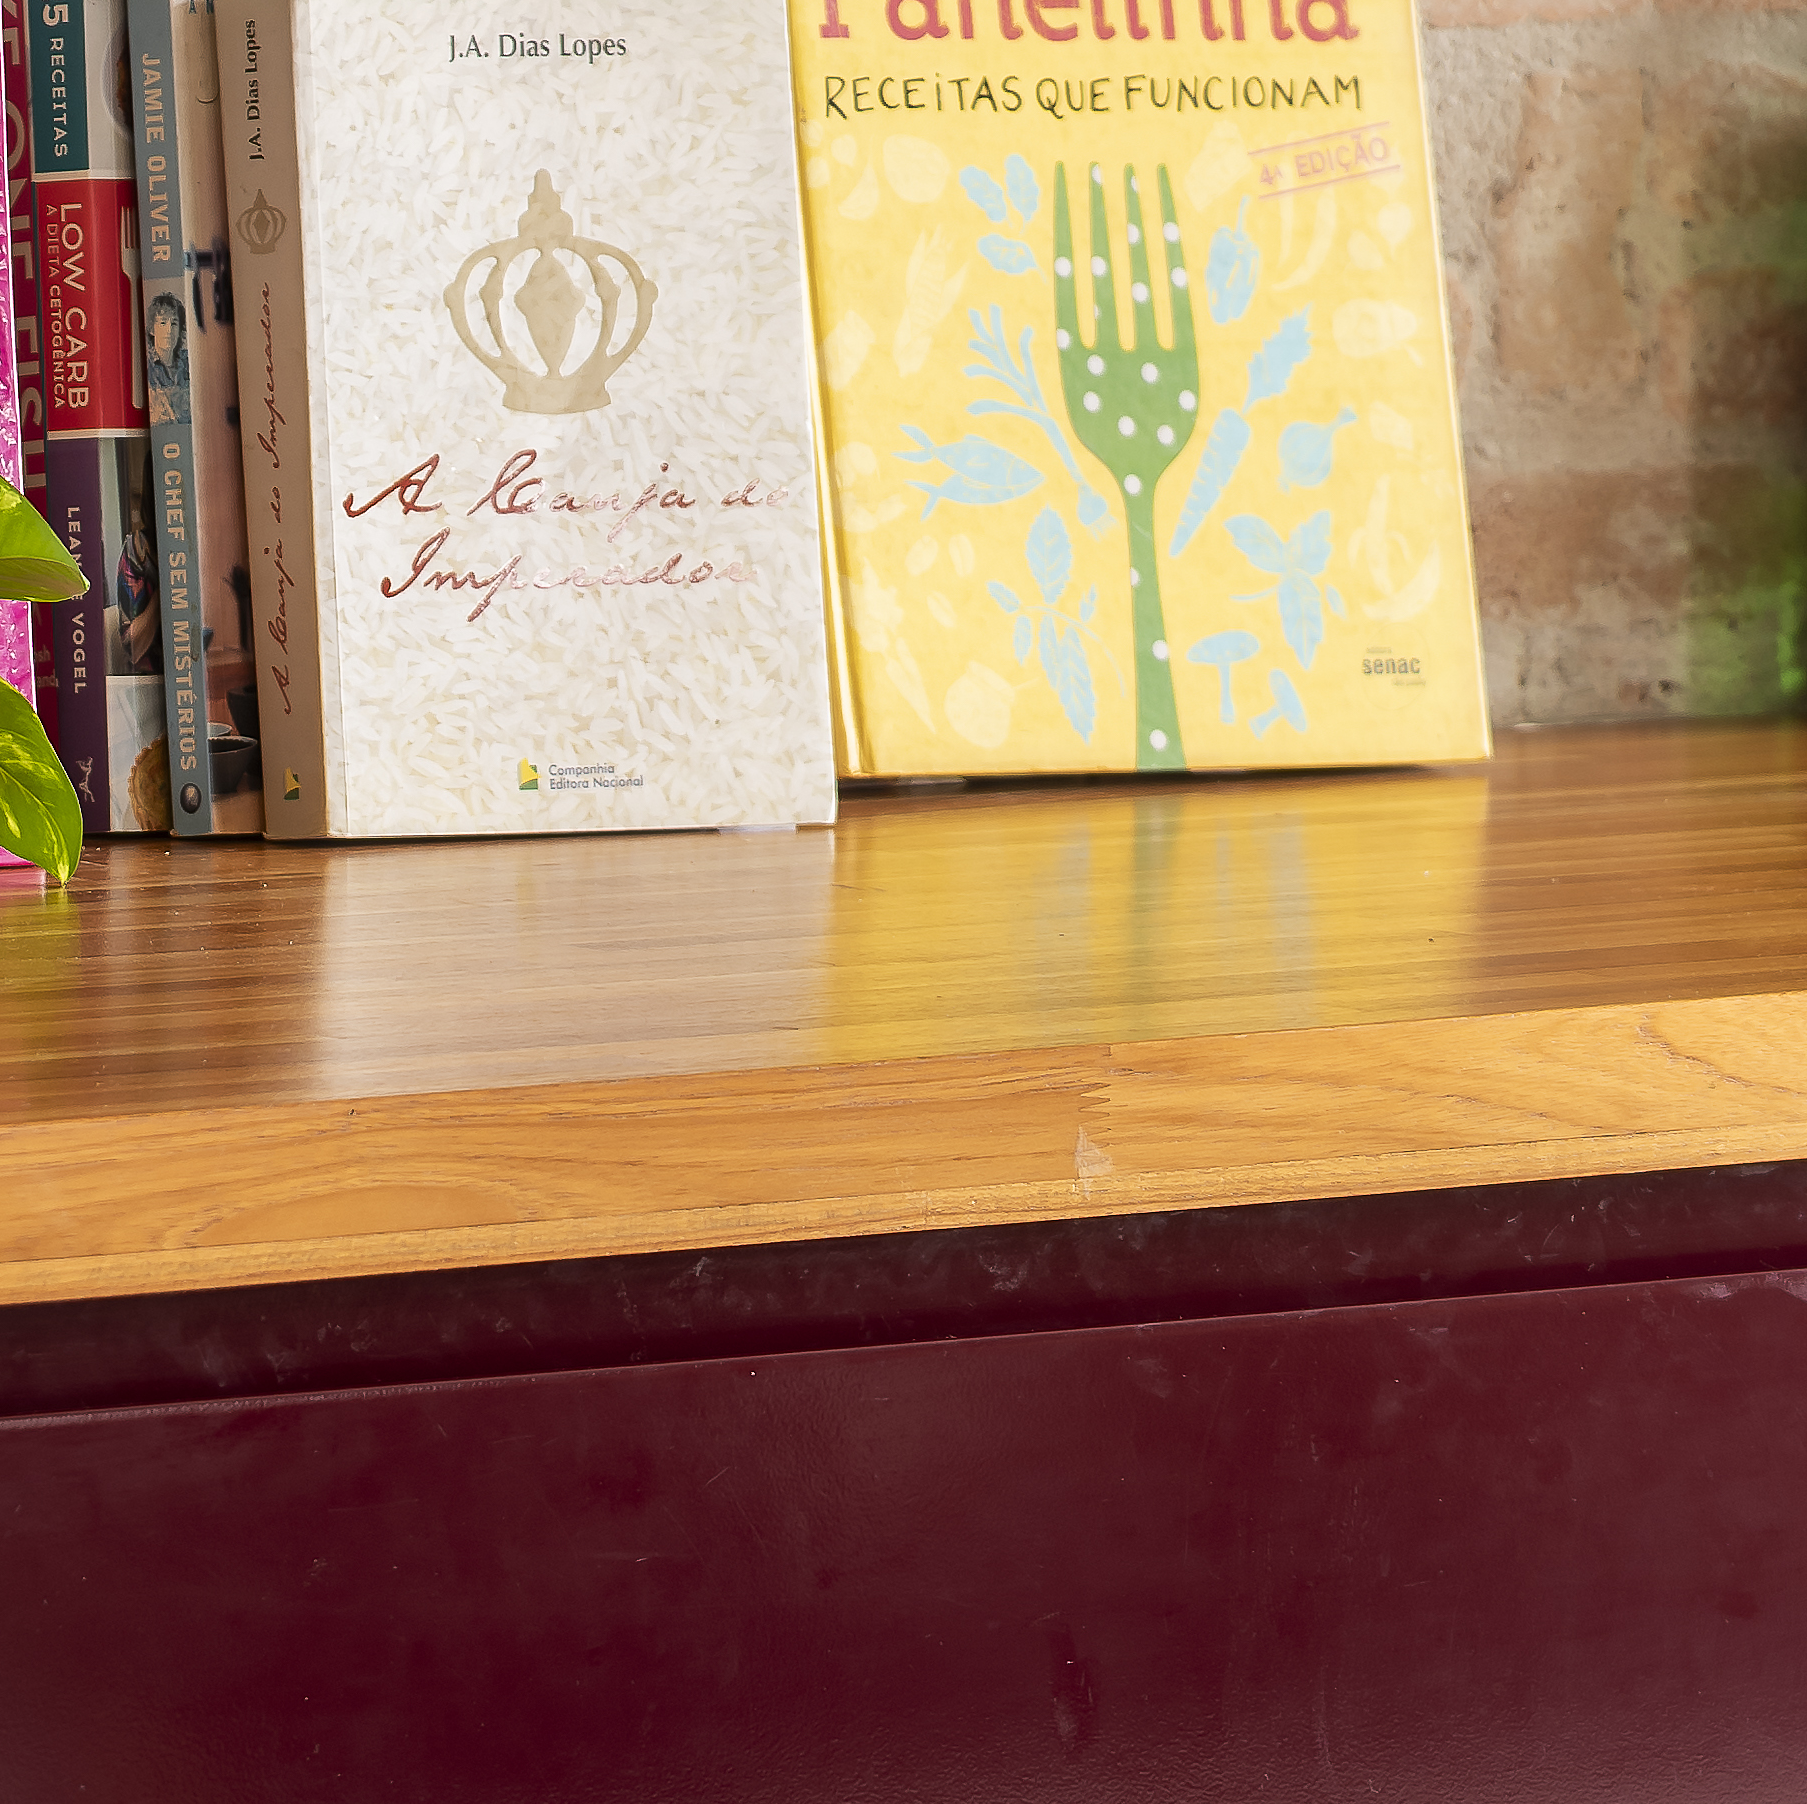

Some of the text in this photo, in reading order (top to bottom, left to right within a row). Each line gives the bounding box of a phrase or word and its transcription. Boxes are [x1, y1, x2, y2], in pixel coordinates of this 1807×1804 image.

[448, 32, 627, 65] J.A. Dias Lopes
[49, 37, 69, 157] RECEITAS
[244, 19, 265, 161] J.A. Dias Lopes
[1034, 76, 1111, 119] QUE
[1123, 73, 1363, 113] FUNCIONAM
[143, 53, 171, 263] JAMIE OLIVER
[1295, 133, 1389, 178] EDIÇÃO
[46, 204, 66, 408] A DIETA CETOGÊNICA
[60, 203, 90, 409] LOW CARB
[256, 281, 287, 469] Imperador
[162, 442, 181, 459] O
[163, 470, 185, 542] CHEF
[342, 453, 443, 518] A
[169, 552, 188, 611] SEM
[380, 527, 758, 623] Imperador
[71, 612, 87, 694] VOGEL
[1362, 658, 1420, 675] senac
[548, 763, 615, 777] Companhia
[549, 775, 644, 790] Editora Nacional
